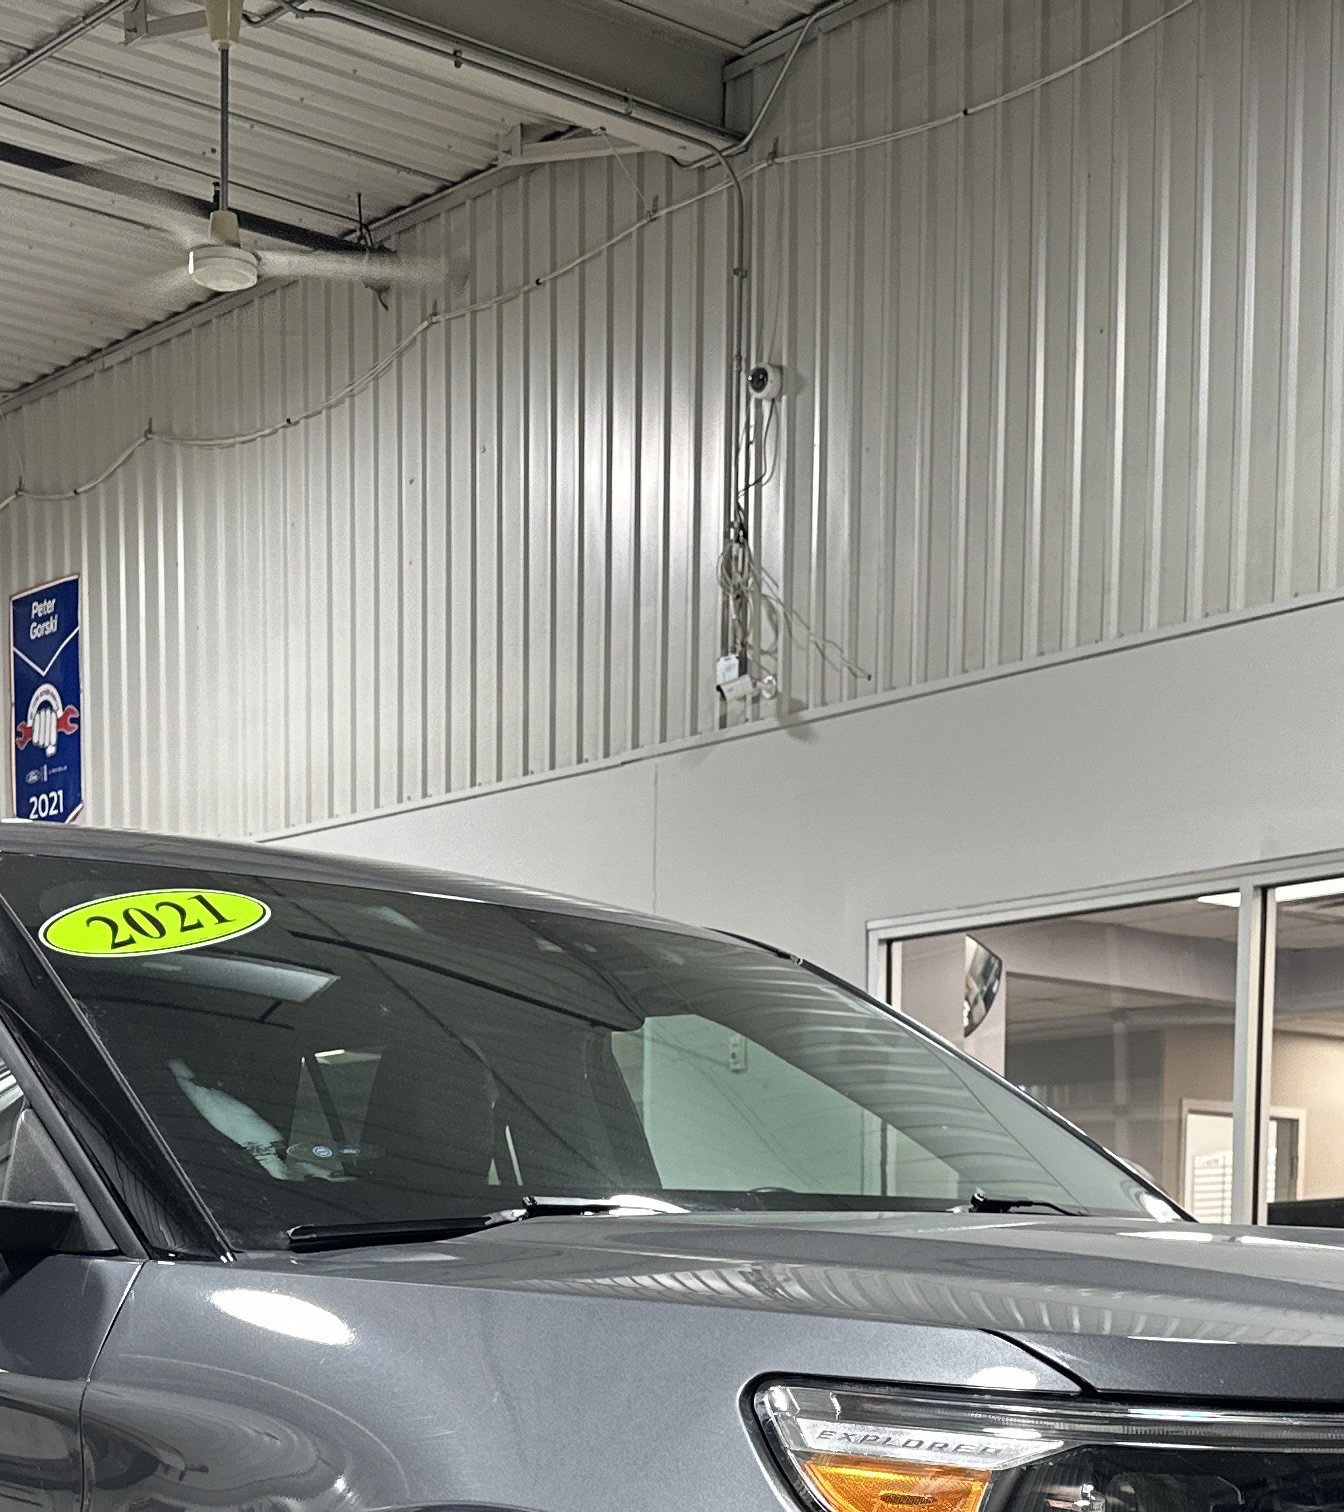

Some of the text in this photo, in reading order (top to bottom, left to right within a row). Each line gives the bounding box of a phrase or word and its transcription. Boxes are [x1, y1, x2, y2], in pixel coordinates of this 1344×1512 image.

[31, 598, 56, 620] Peter
[30, 614, 58, 640] Gorski
[29, 789, 64, 820] 2021
[86, 894, 236, 950] 2021
[816, 1429, 1004, 1456] EXPLORER
